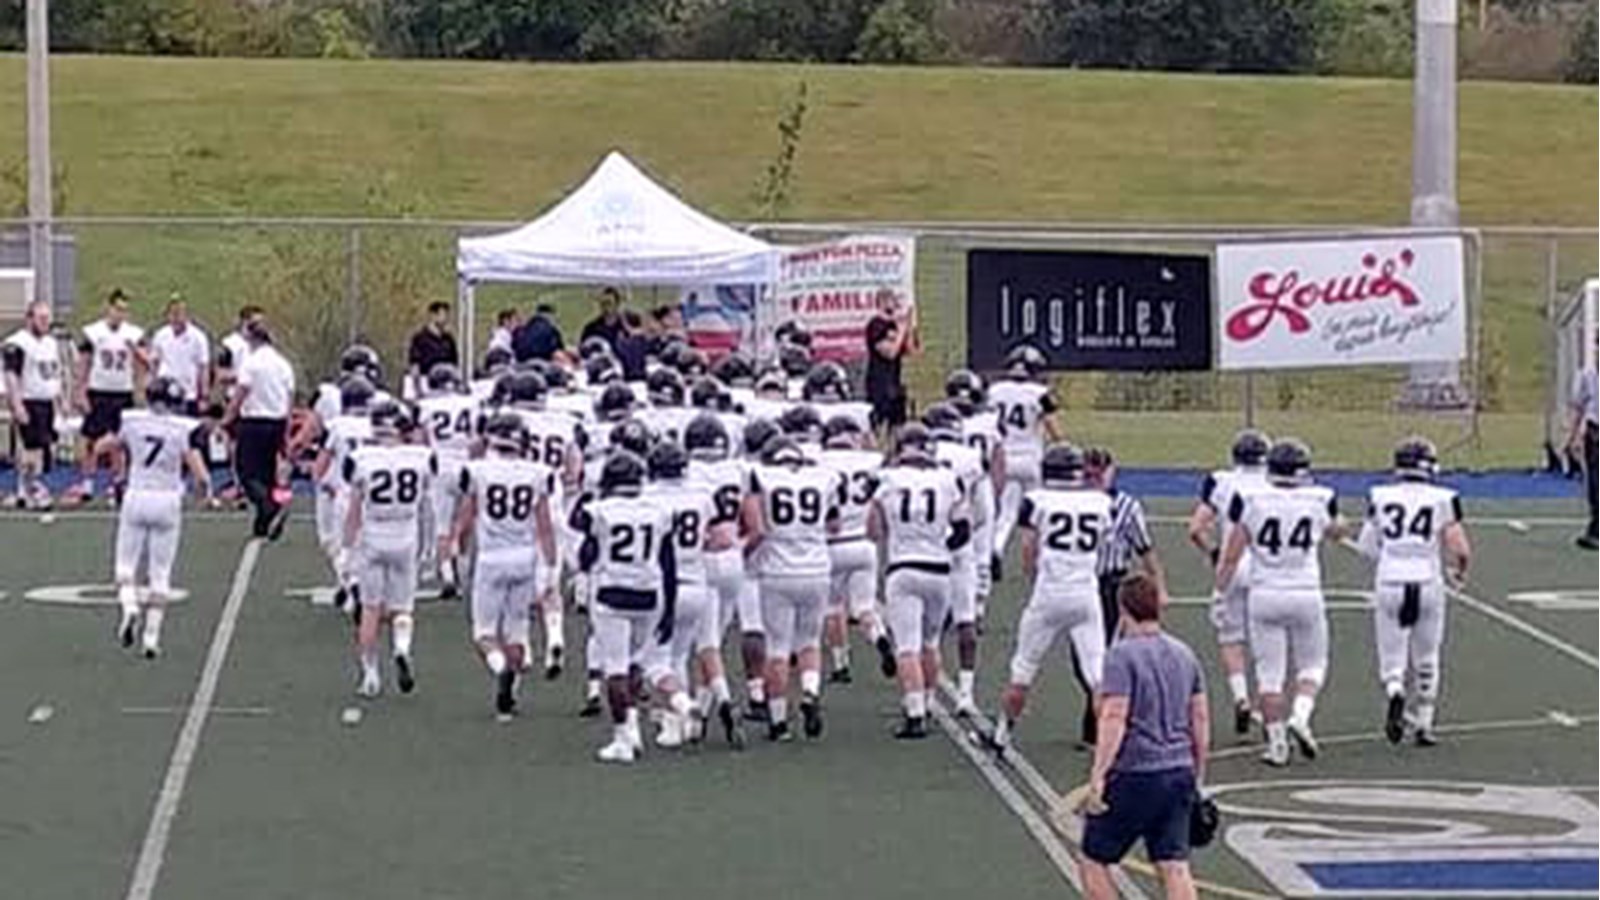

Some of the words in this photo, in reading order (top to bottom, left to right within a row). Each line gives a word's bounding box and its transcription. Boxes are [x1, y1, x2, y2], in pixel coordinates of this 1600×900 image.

[1002, 285, 1176, 346] logiflex
[101, 349, 127, 371] 92
[433, 410, 472, 440] 24
[145, 436, 165, 467] 7
[370, 469, 418, 504] 28
[486, 484, 533, 521] 88
[901, 488, 935, 523] 11
[770, 487, 821, 525] 69
[1383, 503, 1434, 541] 34
[610, 524, 653, 562] 21
[672, 509, 699, 548] 8
[1047, 513, 1098, 551] 25
[1257, 517, 1314, 556] 44
